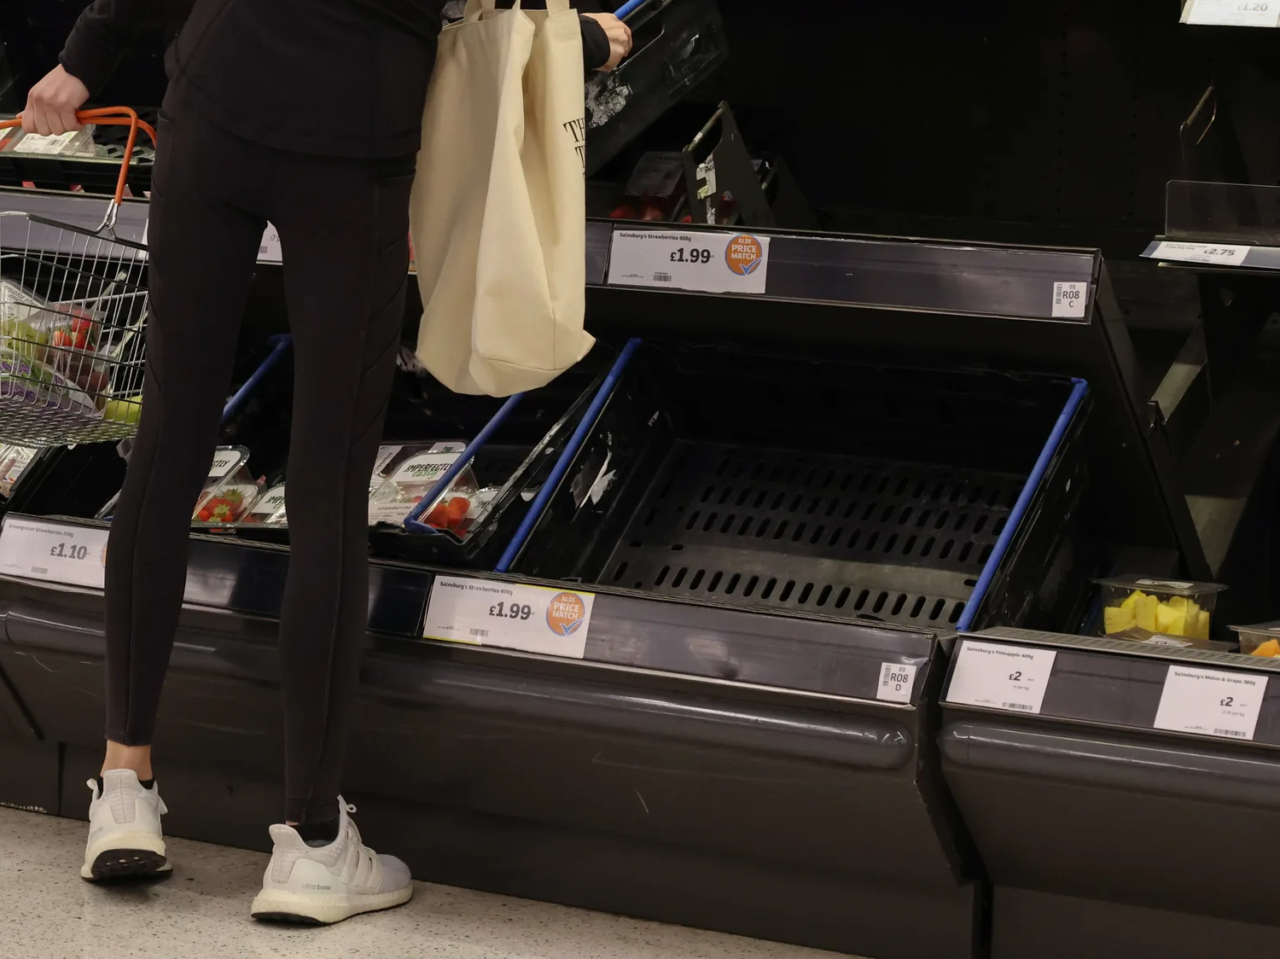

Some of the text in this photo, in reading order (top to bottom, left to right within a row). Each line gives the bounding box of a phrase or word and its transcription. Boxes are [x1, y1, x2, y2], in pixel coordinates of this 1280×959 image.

[619, 232, 647, 240] Sainsbury's
[648, 233, 679, 241] Strawberries
[731, 244, 757, 253] PRICE
[1204, 248, 1236, 256] £2.75
[670, 247, 711, 264] £1.99
[730, 252, 757, 260] MATCH
[1062, 290, 1080, 300] R08
[1068, 300, 1075, 308] C
[35, 526, 63, 537] Strawberries
[50, 543, 88, 560] £1.10
[440, 581, 468, 590] Sainsbury's
[468, 584, 500, 594] Strawberries
[488, 601, 532, 621] £1.99
[553, 601, 581, 613] PRICE
[552, 610, 579, 620] MATCH
[966, 646, 995, 655] Sainsbury's
[995, 649, 1020, 659] Pineapple
[890, 672, 909, 683] R08
[1008, 671, 1022, 682] £2
[1174, 671, 1204, 680] Sainsbury's
[895, 683, 902, 692] D
[1220, 696, 1234, 707] £2
